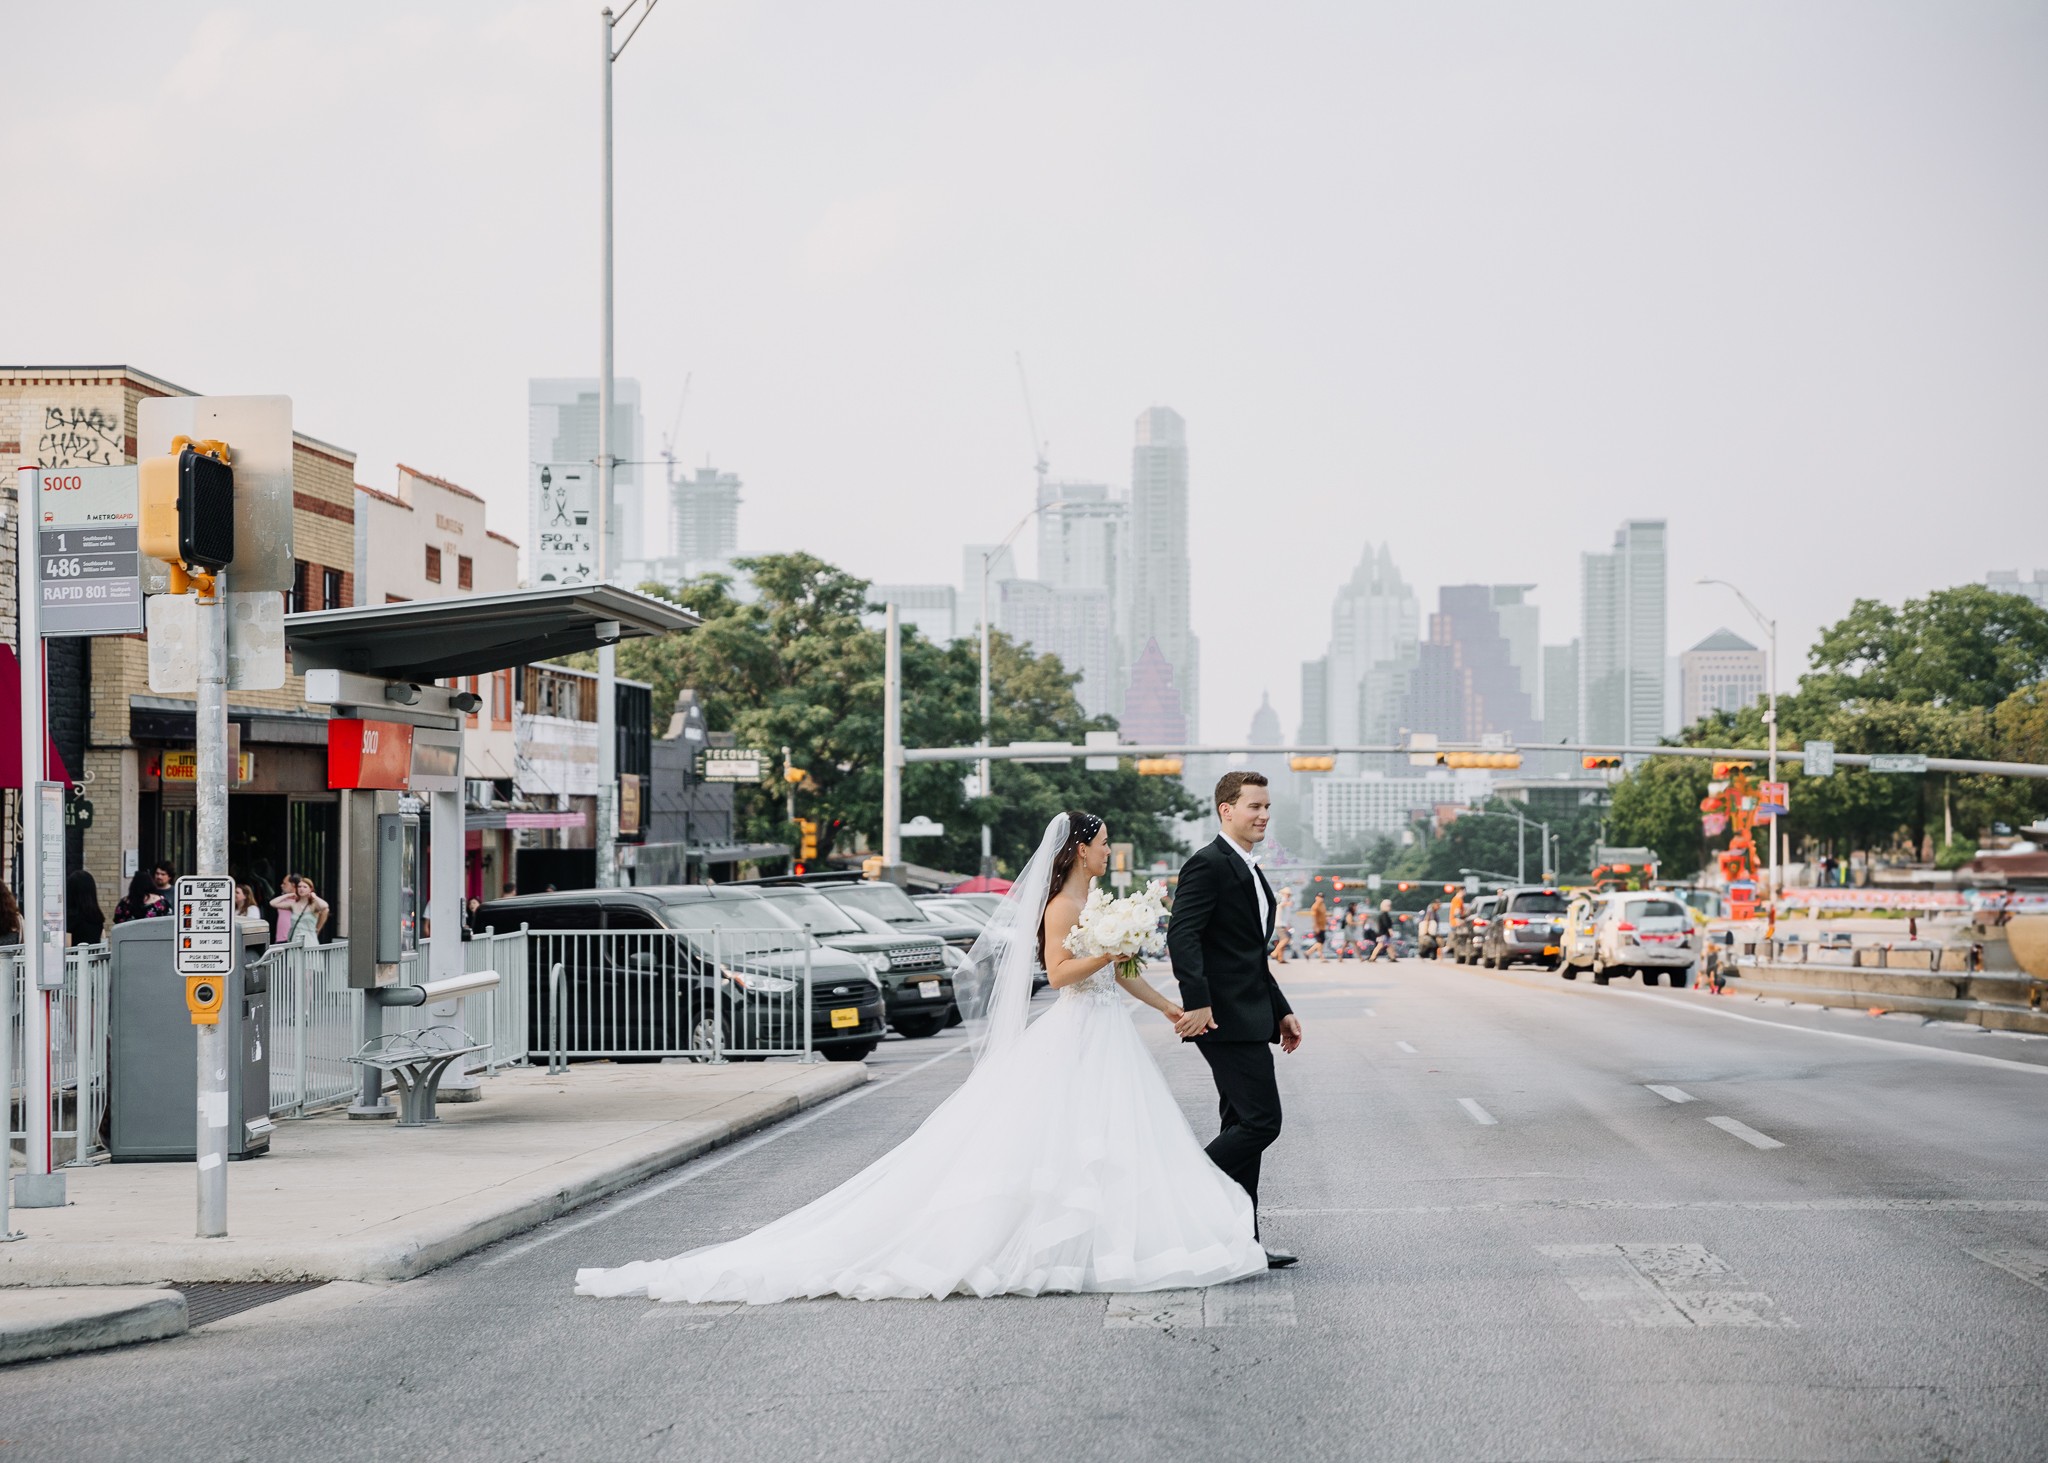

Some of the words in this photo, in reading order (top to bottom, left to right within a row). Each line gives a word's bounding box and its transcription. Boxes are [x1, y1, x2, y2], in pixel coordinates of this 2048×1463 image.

[44, 476, 82, 491] SOCO
[57, 533, 67, 552] 1
[46, 558, 81, 577] 486
[43, 586, 84, 600] RAPID
[85, 585, 107, 599] 801
[705, 749, 761, 760] TECOVAS
[166, 765, 194, 777] COFFEE
